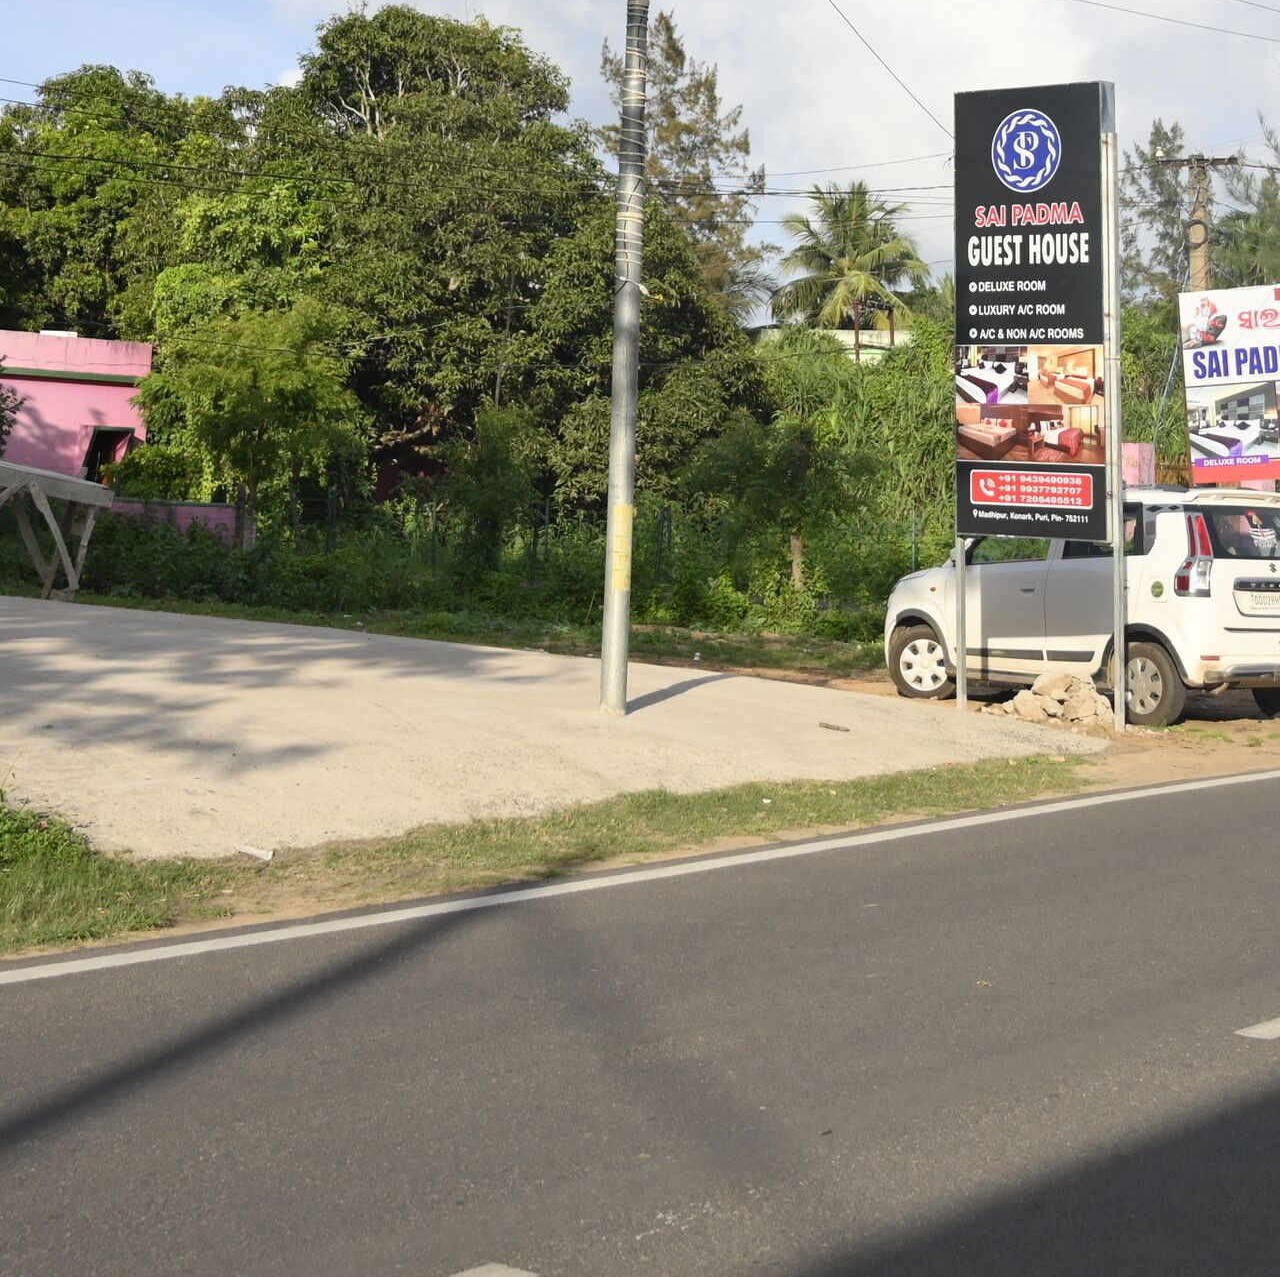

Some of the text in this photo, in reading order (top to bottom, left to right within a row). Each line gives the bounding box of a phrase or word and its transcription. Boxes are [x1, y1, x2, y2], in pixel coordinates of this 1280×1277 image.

[974, 202, 1084, 228] SAI PADMA
[968, 232, 1089, 266] GUEST HOUSE
[978, 280, 1046, 292] DELUXE ROOM
[978, 304, 1065, 315] LUXURY A/C ROOM
[980, 328, 1084, 339] A/C & NON A/C ROOMS
[1192, 349, 1229, 379] SAI
[1203, 457, 1261, 466] DELUXE ROOM
[1020, 475, 1082, 485] 9439490938
[998, 484, 1082, 494] +91 9937792707
[998, 494, 1082, 505] +91 7205495512
[978, 510, 1009, 521] Madhipur,
[1010, 512, 1034, 521] Konark,
[1035, 513, 1050, 522] Puri,
[1065, 515, 1088, 523] 752111
